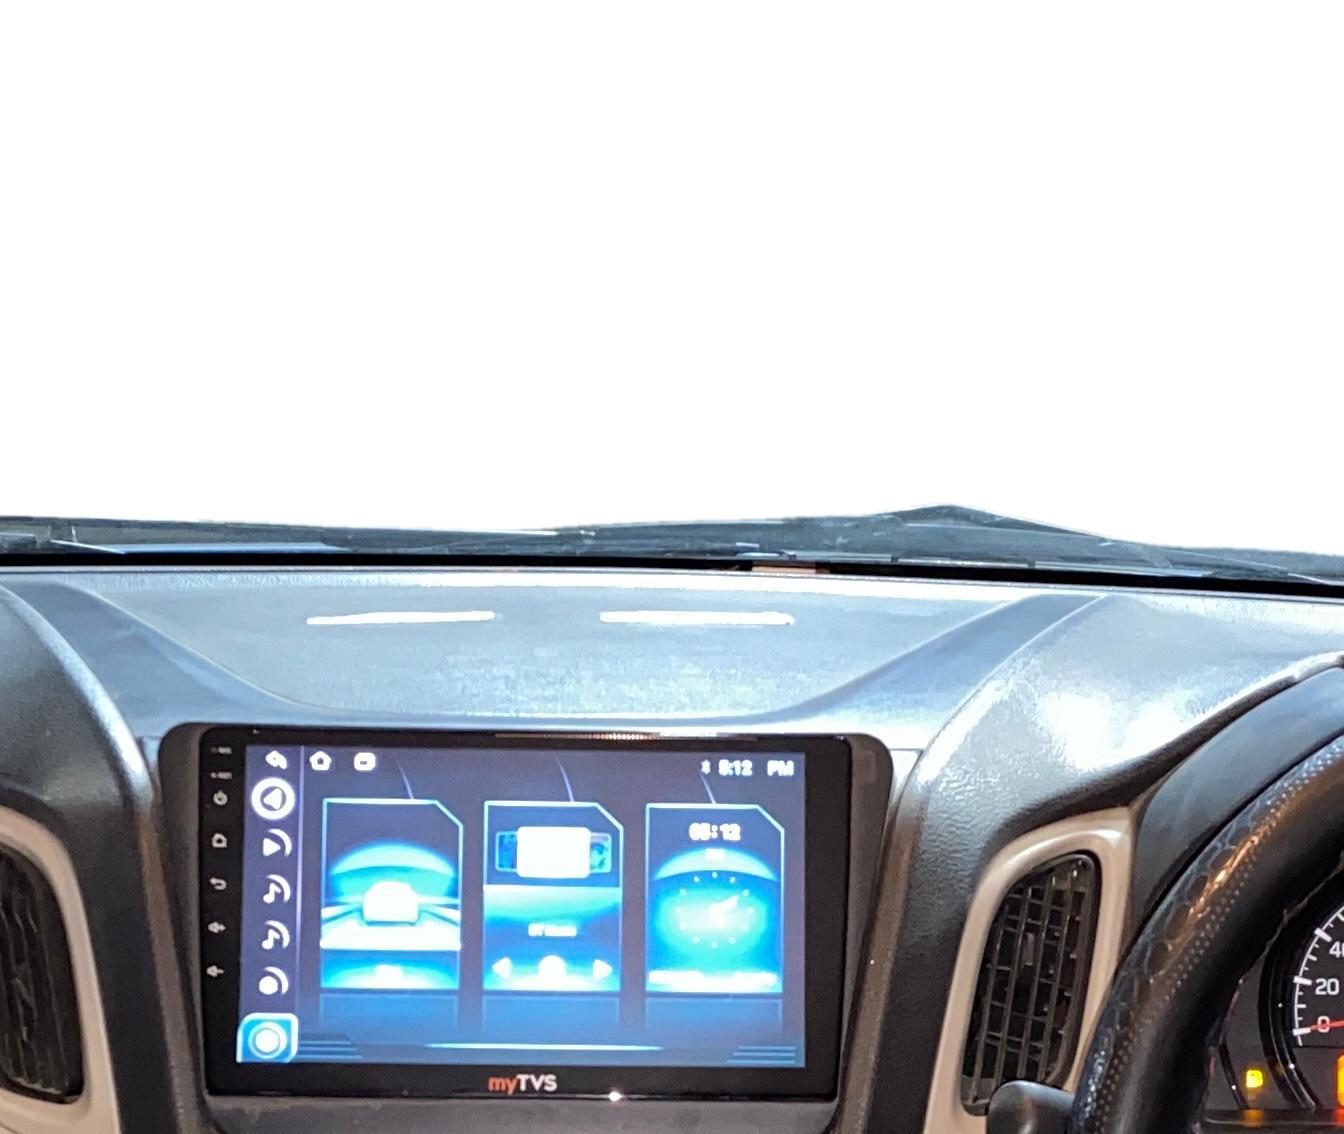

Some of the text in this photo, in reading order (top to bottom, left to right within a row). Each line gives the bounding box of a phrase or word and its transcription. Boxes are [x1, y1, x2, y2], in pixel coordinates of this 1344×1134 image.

[1315, 978, 1340, 995] 20
[1317, 1016, 1331, 1033] 0
[488, 1074, 558, 1095] myTVS
